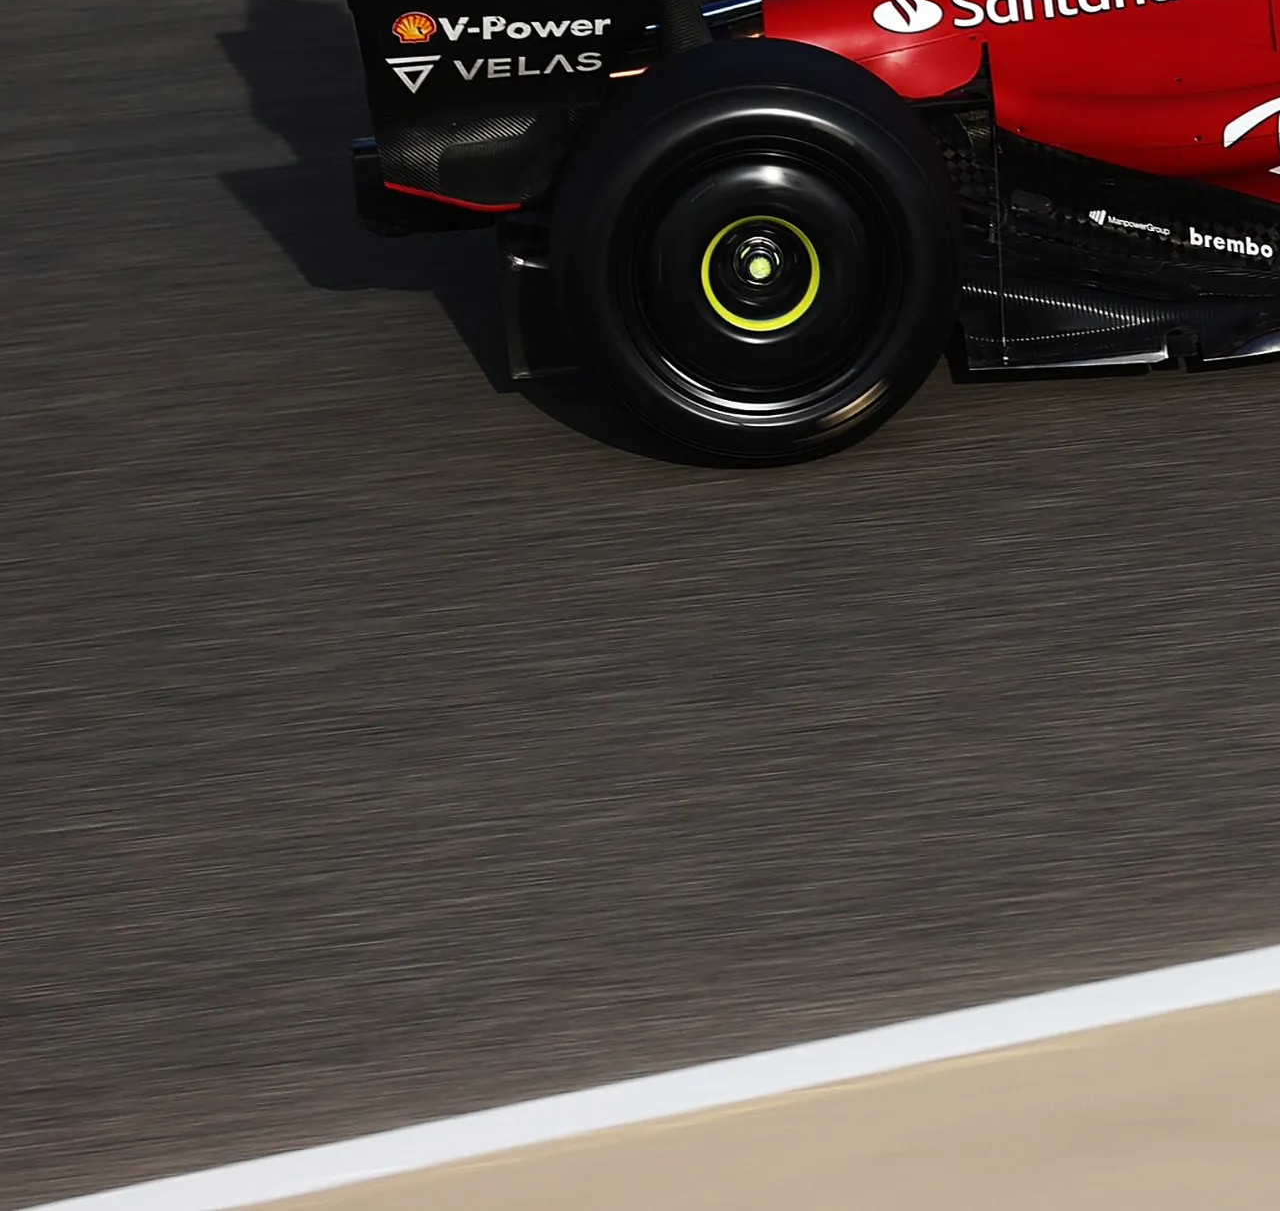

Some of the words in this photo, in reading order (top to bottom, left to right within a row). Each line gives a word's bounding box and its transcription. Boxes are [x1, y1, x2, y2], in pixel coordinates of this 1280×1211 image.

[438, 14, 611, 41] V-Power
[453, 51, 602, 81] VELAS
[1107, 215, 1171, 236] ManpowerGroup
[1189, 226, 1273, 258] brembo
